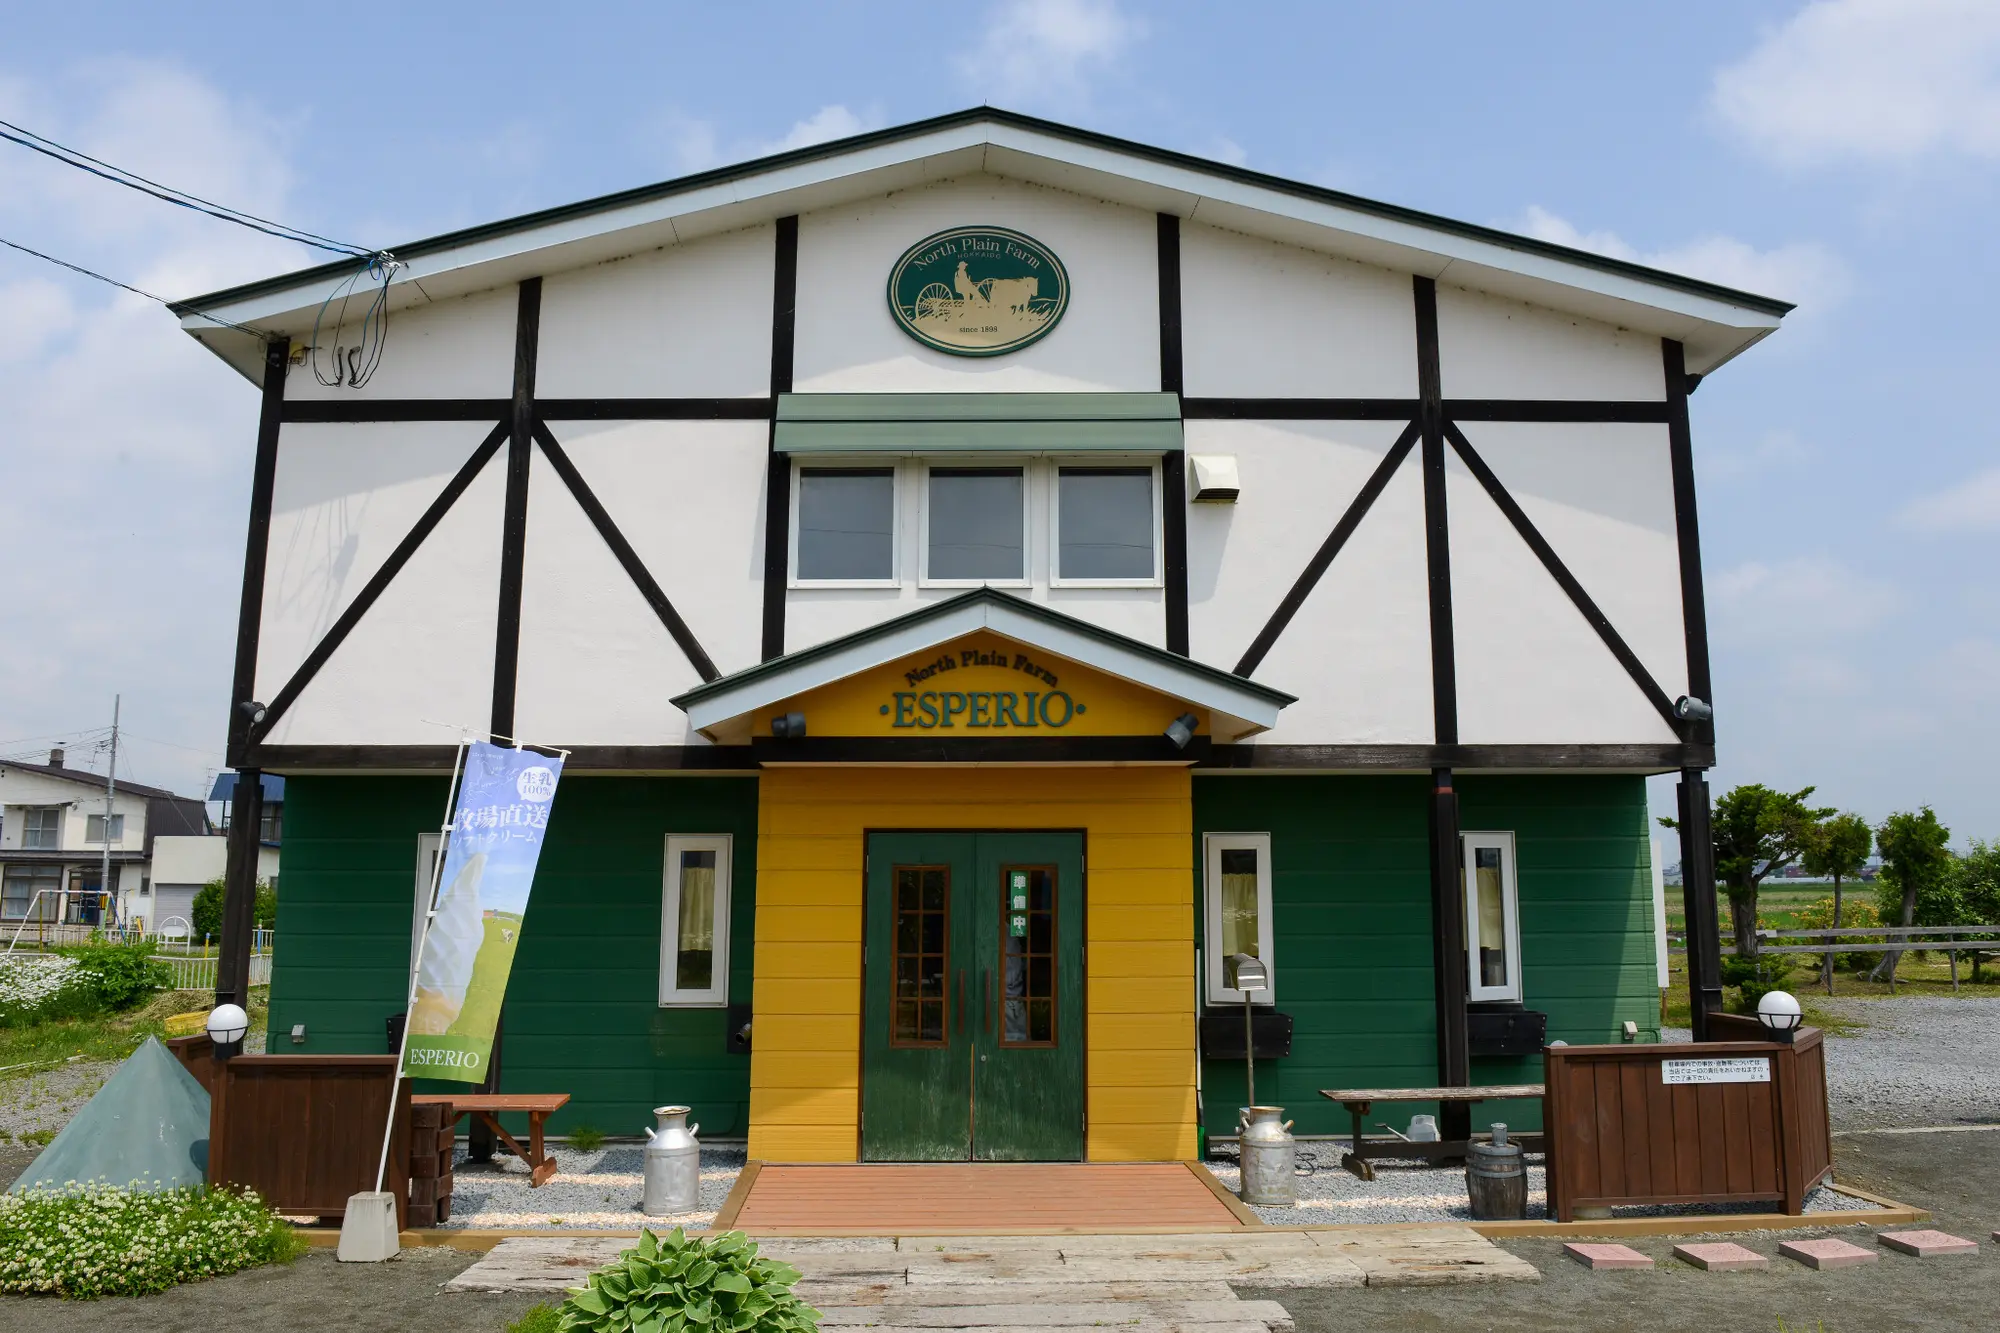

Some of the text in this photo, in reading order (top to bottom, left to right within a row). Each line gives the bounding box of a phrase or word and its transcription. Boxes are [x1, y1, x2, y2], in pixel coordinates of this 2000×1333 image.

[913, 238, 1040, 271] North Plain Farm
[957, 251, 1001, 260] HOKKAIDO
[959, 325, 978, 333] since
[904, 650, 1059, 688] North Plain Farm
[892, 691, 1074, 728] ESPERIO
[523, 771, 552, 786] 生乳
[523, 785, 551, 797] 100%
[454, 804, 548, 834] 牧場直送
[1013, 875, 1026, 930] 準備中
[410, 1048, 479, 1069] ESPERIO
